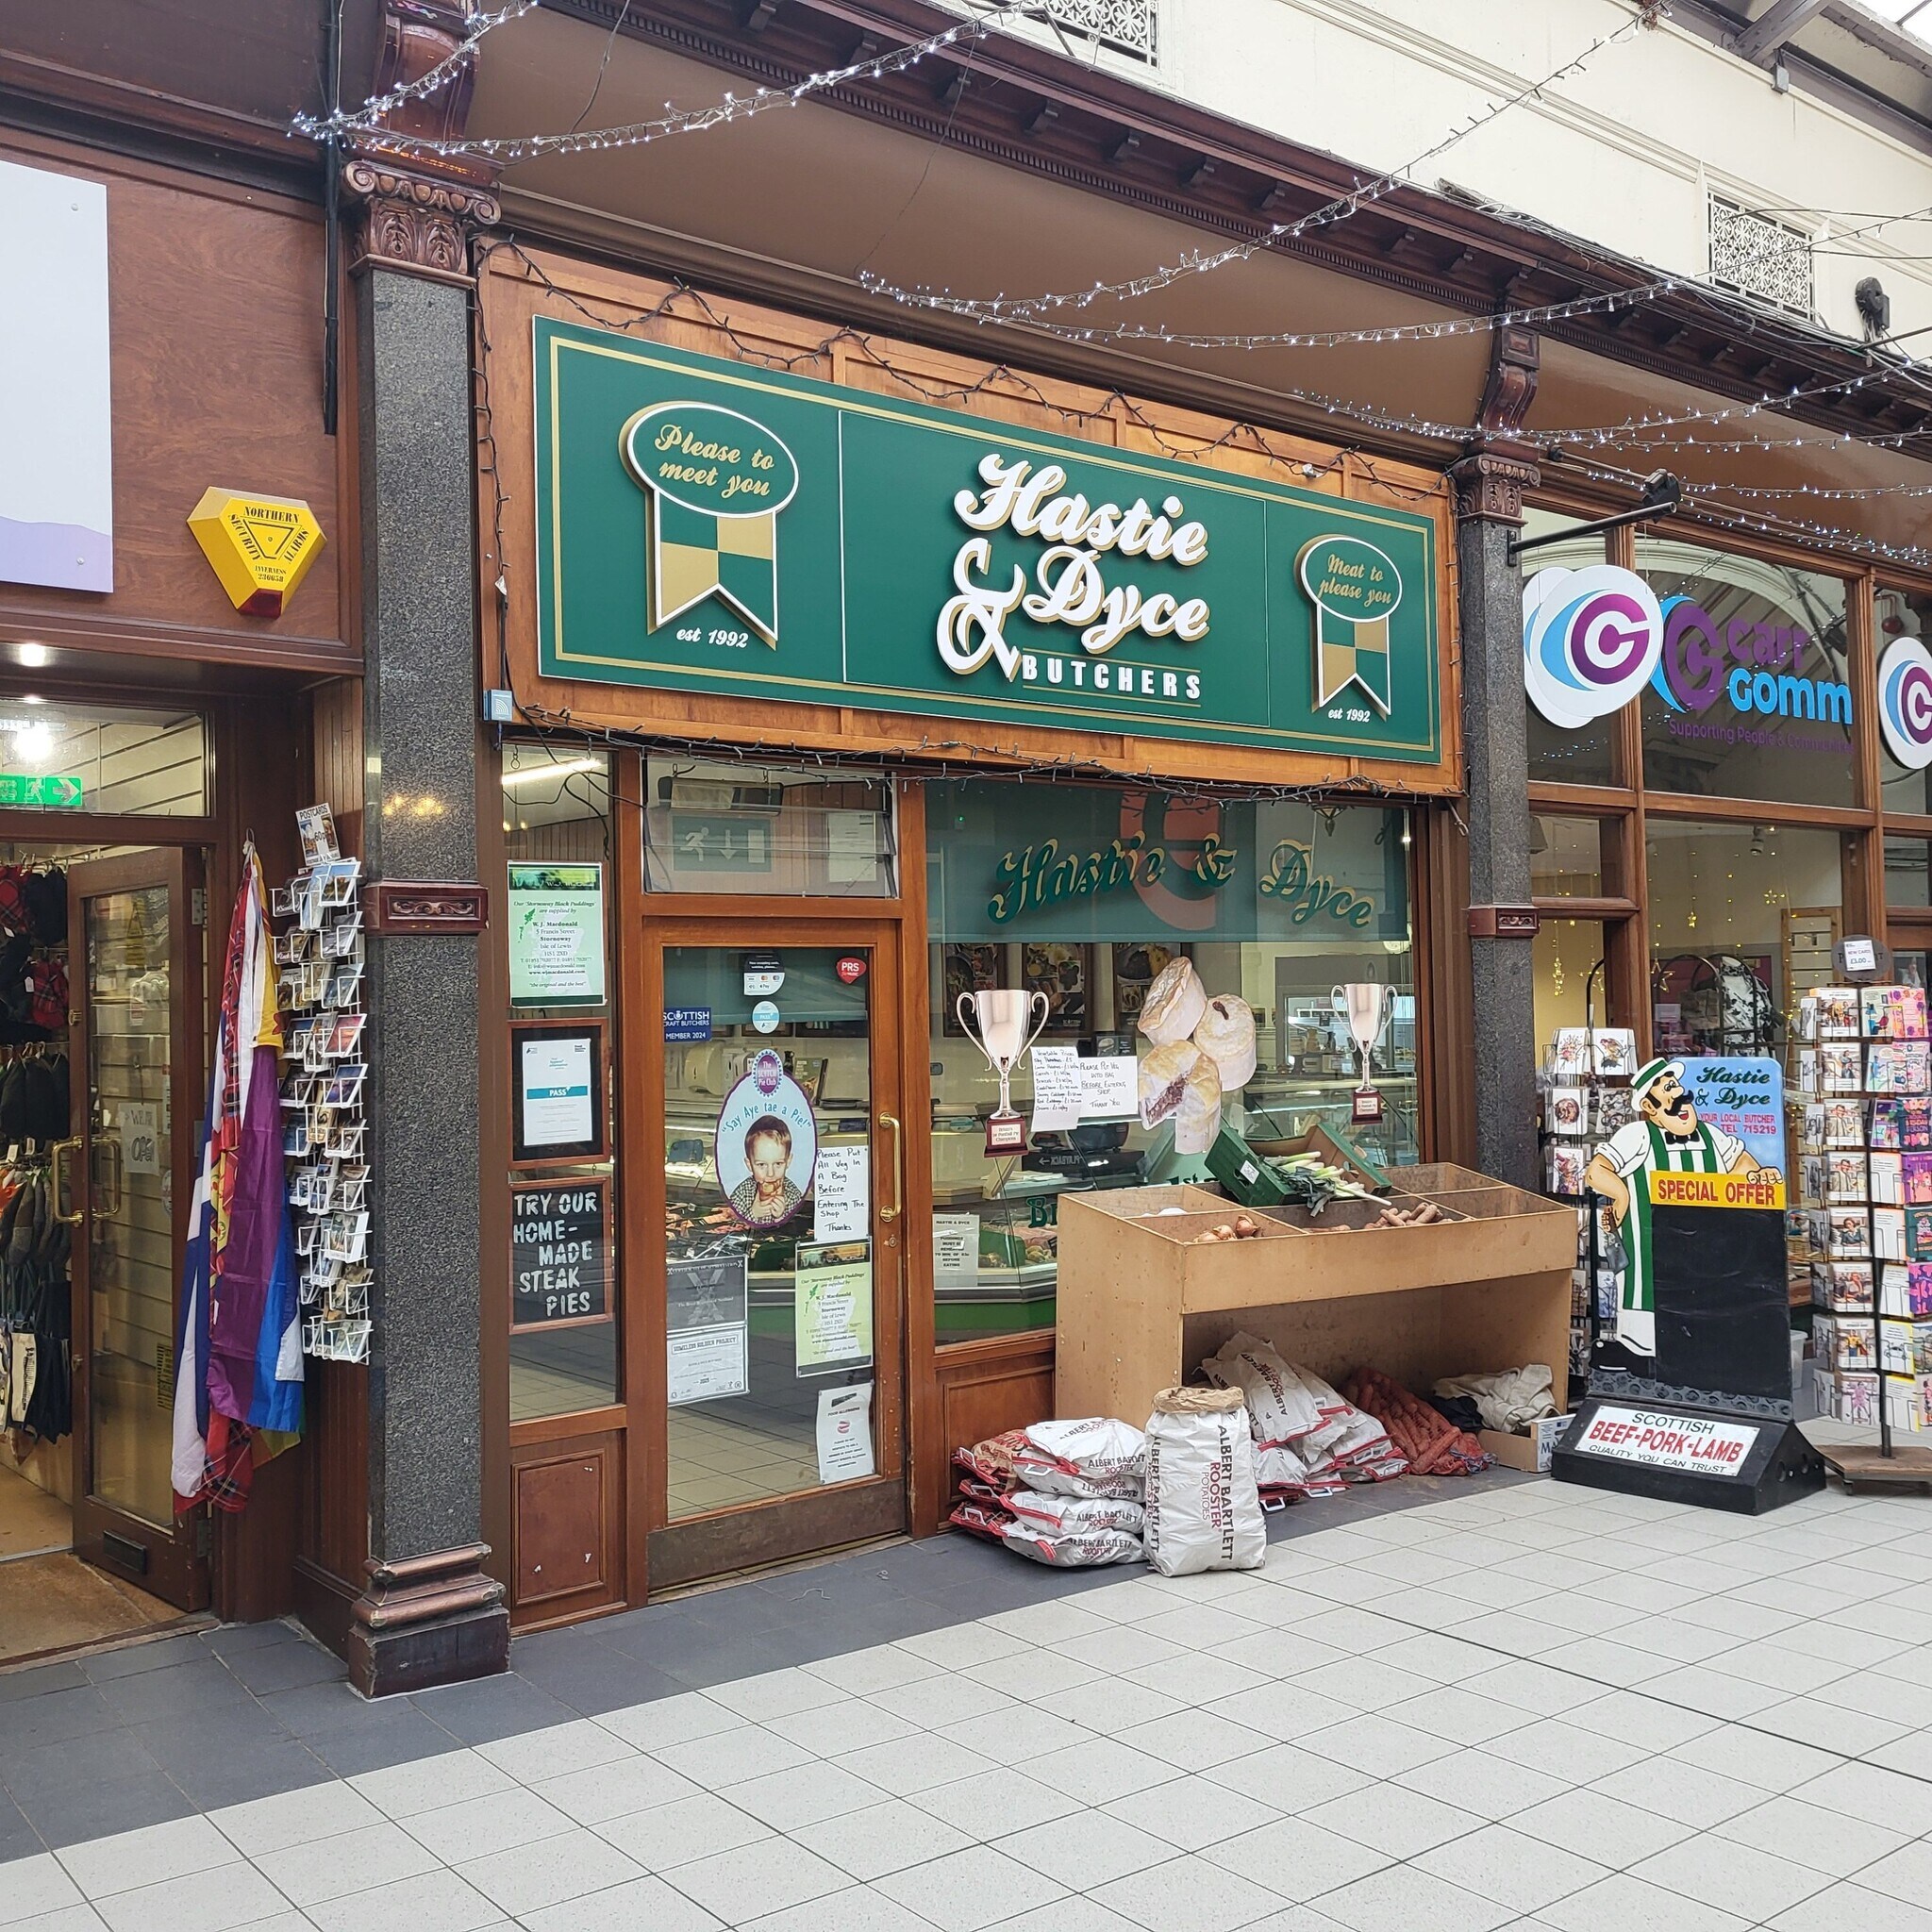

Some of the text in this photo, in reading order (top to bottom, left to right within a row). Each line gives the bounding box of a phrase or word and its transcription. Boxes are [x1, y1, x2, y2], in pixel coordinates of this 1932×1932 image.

[655, 424, 774, 470] Please to
[659, 460, 771, 499] meet you
[244, 506, 299, 524] NORTHERN
[954, 453, 1208, 566] Hastie
[228, 513, 262, 560] SECURITY
[283, 527, 309, 564] ALARMS
[255, 565, 287, 575] INVERNESS
[1327, 554, 1384, 582] Meat to
[1318, 577, 1391, 608] please you
[937, 538, 1209, 682] & Dyce
[675, 627, 748, 648] est 1992
[1023, 654, 1201, 700] BUTCHERS
[1728, 667, 1854, 725] Gomm
[1328, 708, 1371, 723] est 1992
[1669, 719, 1734, 745] Supporting
[1737, 726, 1776, 747] People
[299, 805, 328, 820] POSTCARDS
[988, 830, 1376, 929] Hastie & Dyce
[841, 962, 859, 972] PRS
[663, 1010, 709, 1021] SCOTTISH
[1079, 1062, 1099, 1071] PLEASE
[1696, 1066, 1771, 1084] Hastie
[549, 1089, 567, 1097] PASS
[766, 1077, 776, 1086] Club
[1694, 1087, 1771, 1110] & Dyce
[743, 1105, 758, 1120] Aye
[764, 1103, 777, 1112] tae
[781, 1106, 787, 1114] a
[1699, 1113, 1775, 1124] YOUR LOCAL BUTCHER
[1721, 1124, 1776, 1135] TEL 715219
[817, 1148, 860, 1158] Please Put
[818, 1160, 829, 1169] All
[835, 1159, 848, 1171] Veg
[818, 1184, 845, 1194] Before
[831, 1172, 847, 1182] Bag
[514, 1191, 597, 1216] TRY OUR
[1657, 1179, 1775, 1206] SPECIAL OFFER
[817, 1200, 848, 1211] Entering
[513, 1220, 577, 1244] HOME-
[824, 1223, 852, 1232] Thanks
[539, 1240, 592, 1266] MADE
[519, 1266, 579, 1293] STEAK
[545, 1291, 591, 1317] PIES
[1268, 1383, 1288, 1415] ALBERT
[1631, 1412, 1715, 1435] SCOTTISH
[1088, 1457, 1116, 1468] ALBERT
[1589, 1444, 1727, 1474] QUALITY YOU CAN TRUST
[1201, 1472, 1210, 1521] POTATOES
[1209, 1462, 1222, 1529] ROOSTER
[1217, 1424, 1234, 1560] ALBERT BARTLETT
[1151, 1486, 1161, 1554] BARTLETT
